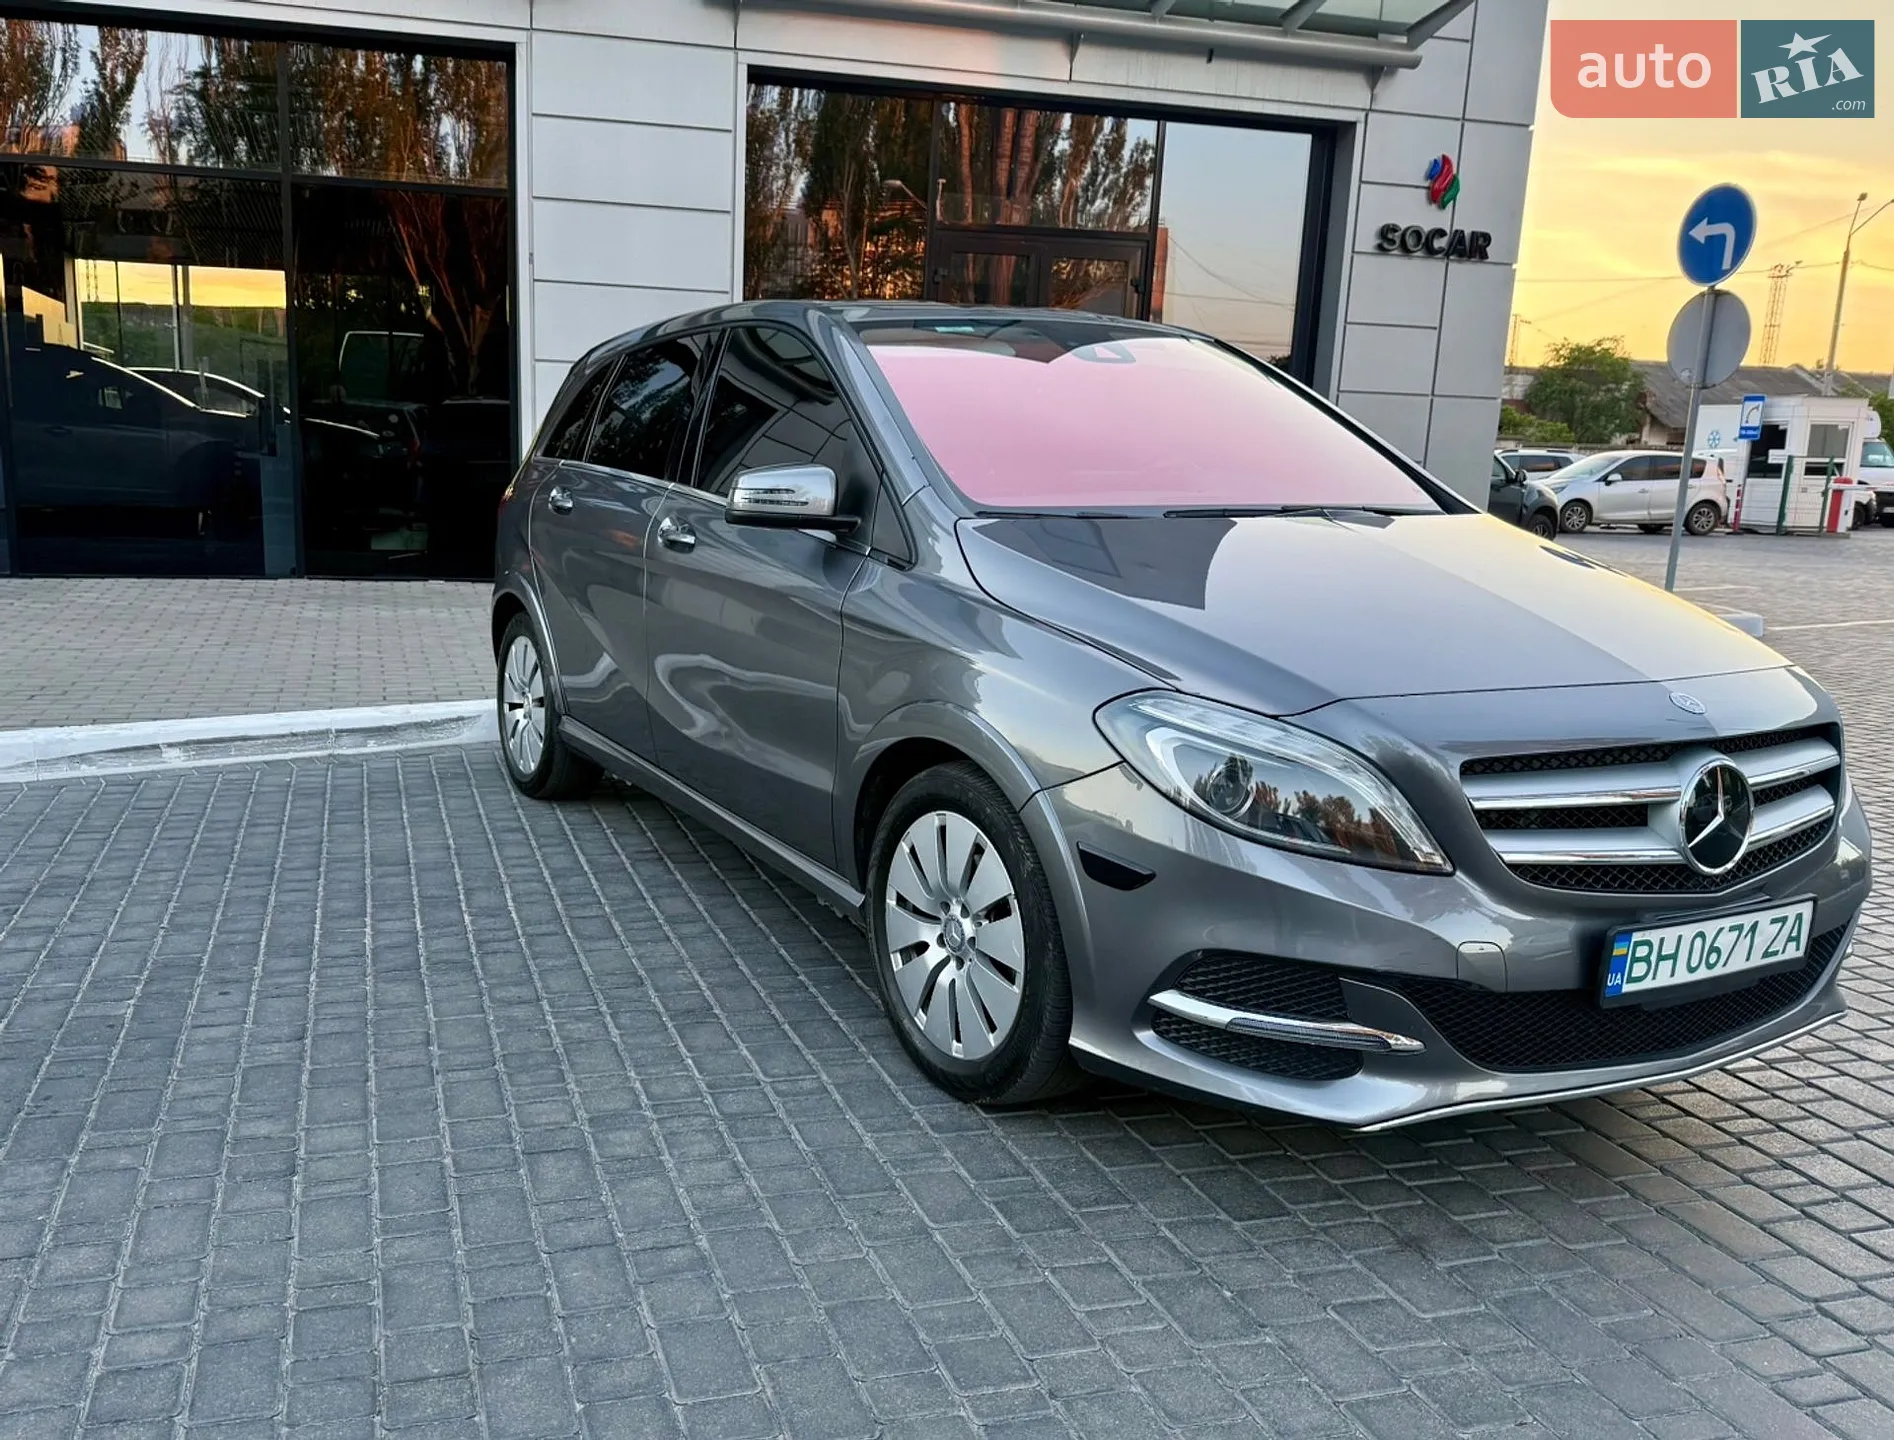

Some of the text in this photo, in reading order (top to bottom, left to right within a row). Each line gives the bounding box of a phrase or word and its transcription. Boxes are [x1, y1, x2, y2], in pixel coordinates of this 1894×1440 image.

[1376, 222, 1492, 260] SOCAR
[1625, 912, 1804, 984] BH 0671 ZA
[1607, 971, 1622, 987] UA
